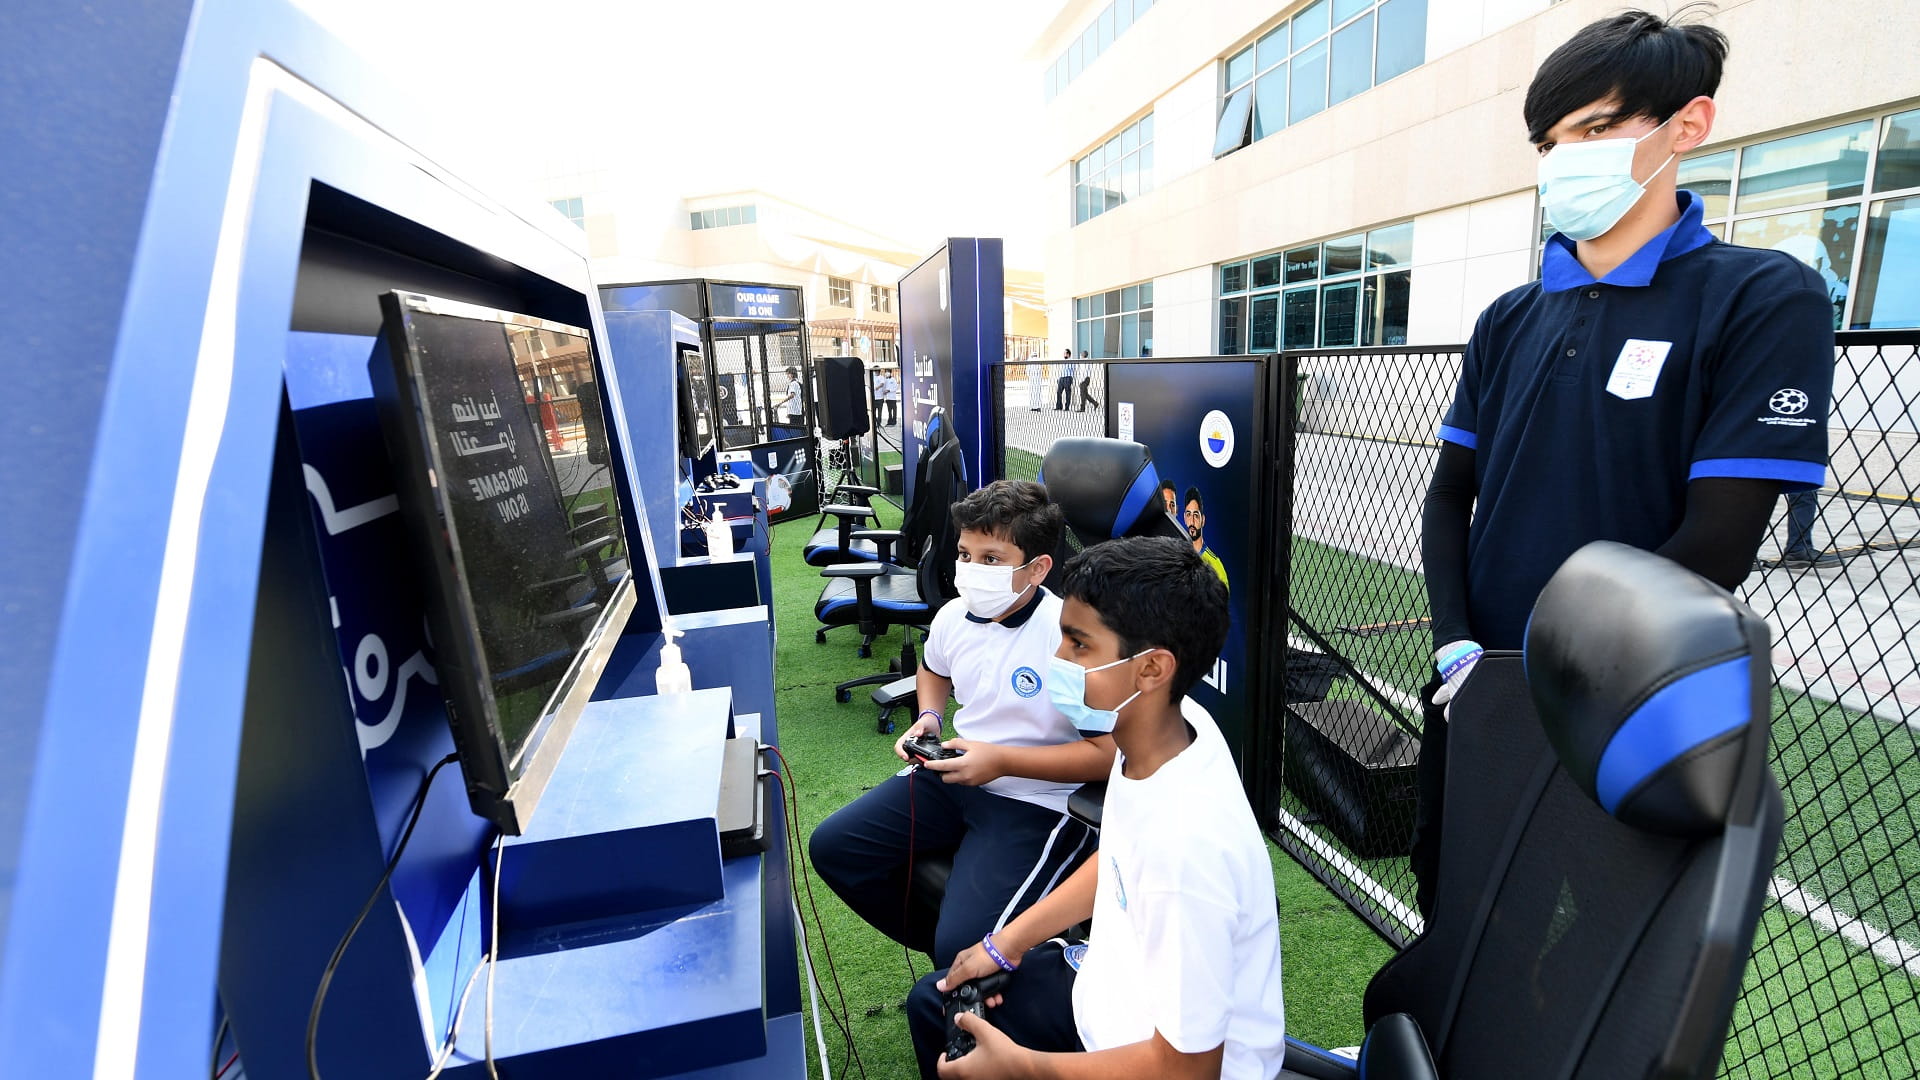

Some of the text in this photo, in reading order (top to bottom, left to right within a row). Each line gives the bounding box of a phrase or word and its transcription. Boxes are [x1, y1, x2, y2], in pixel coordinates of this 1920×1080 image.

[736, 292, 780, 304] OUR GAME
[748, 305, 757, 316] IS
[913, 419, 923, 440] OUR
